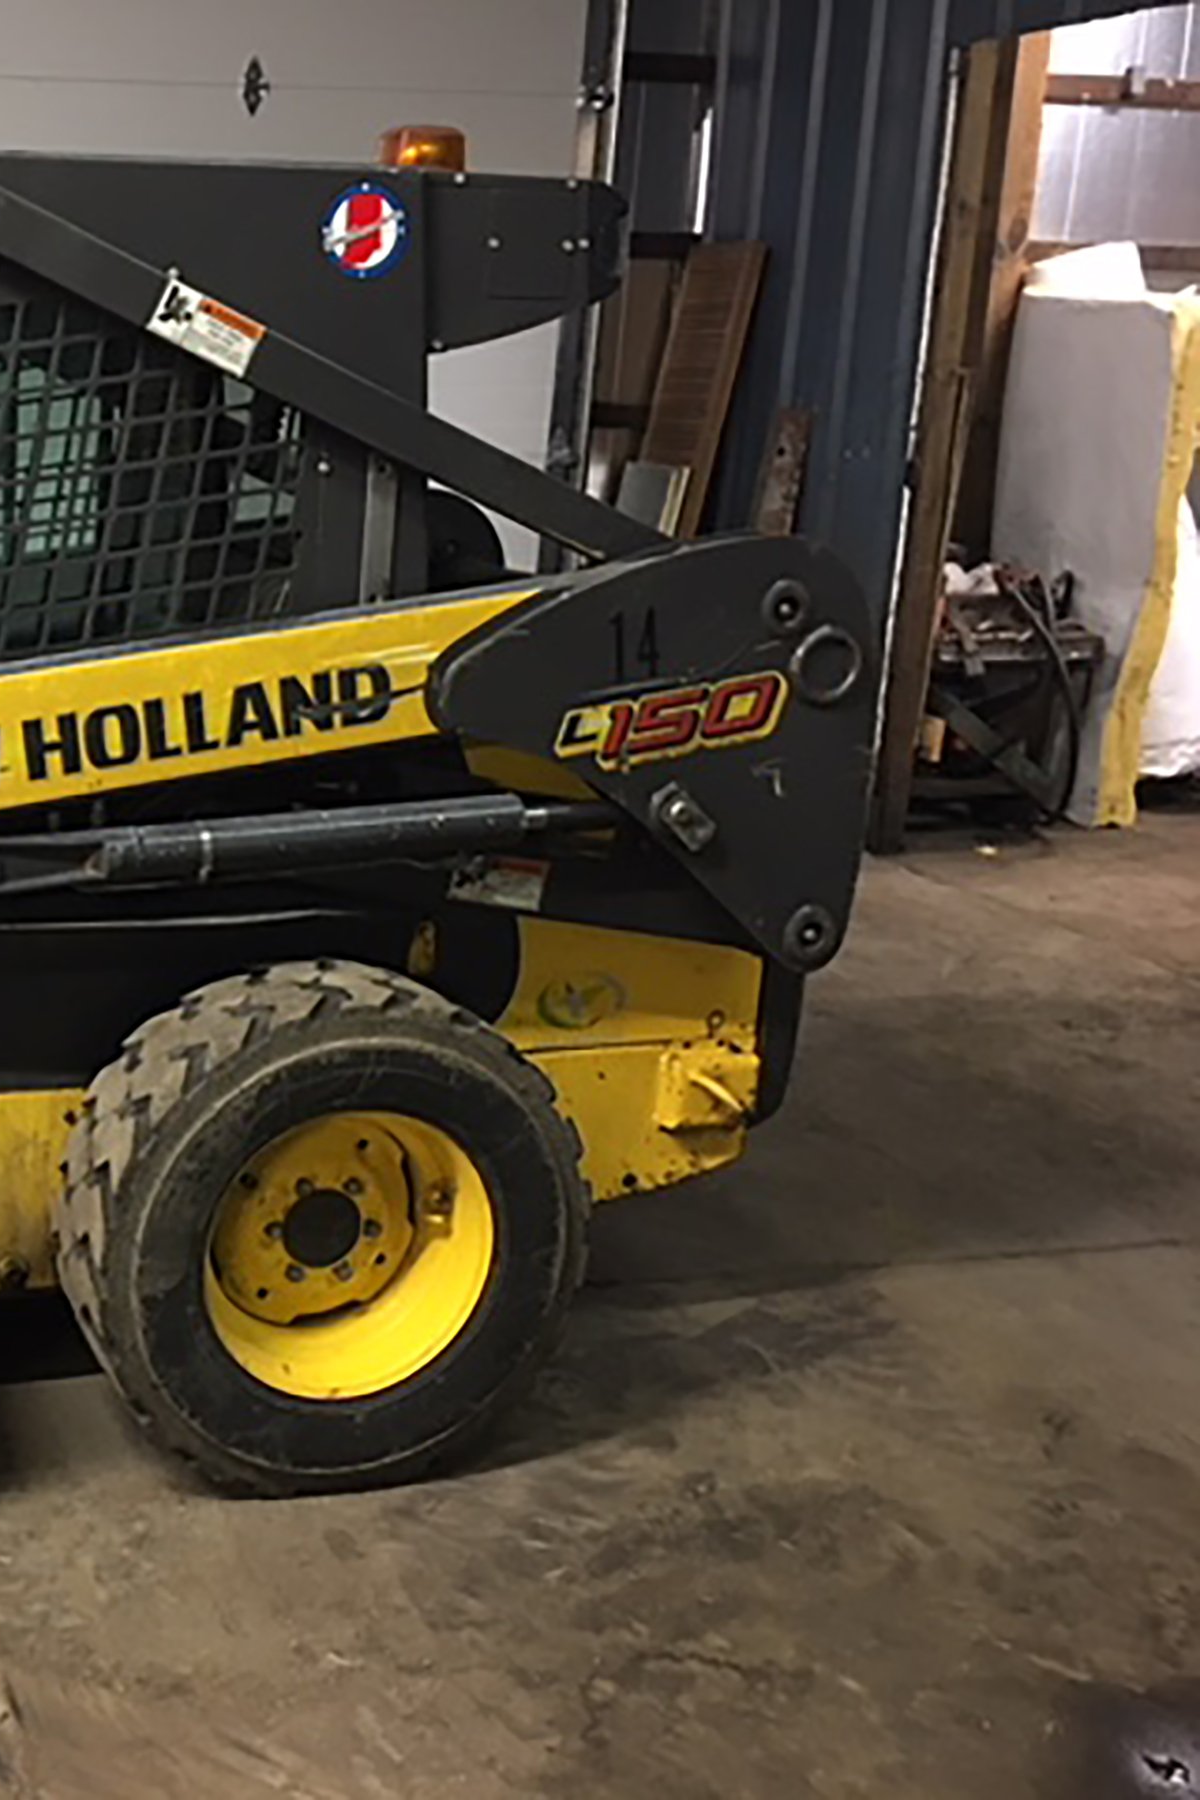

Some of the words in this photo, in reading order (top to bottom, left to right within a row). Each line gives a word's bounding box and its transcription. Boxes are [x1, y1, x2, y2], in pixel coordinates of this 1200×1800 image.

[609, 606, 659, 683] 14
[21, 663, 392, 780] HOLLAND
[557, 672, 785, 767] L150
